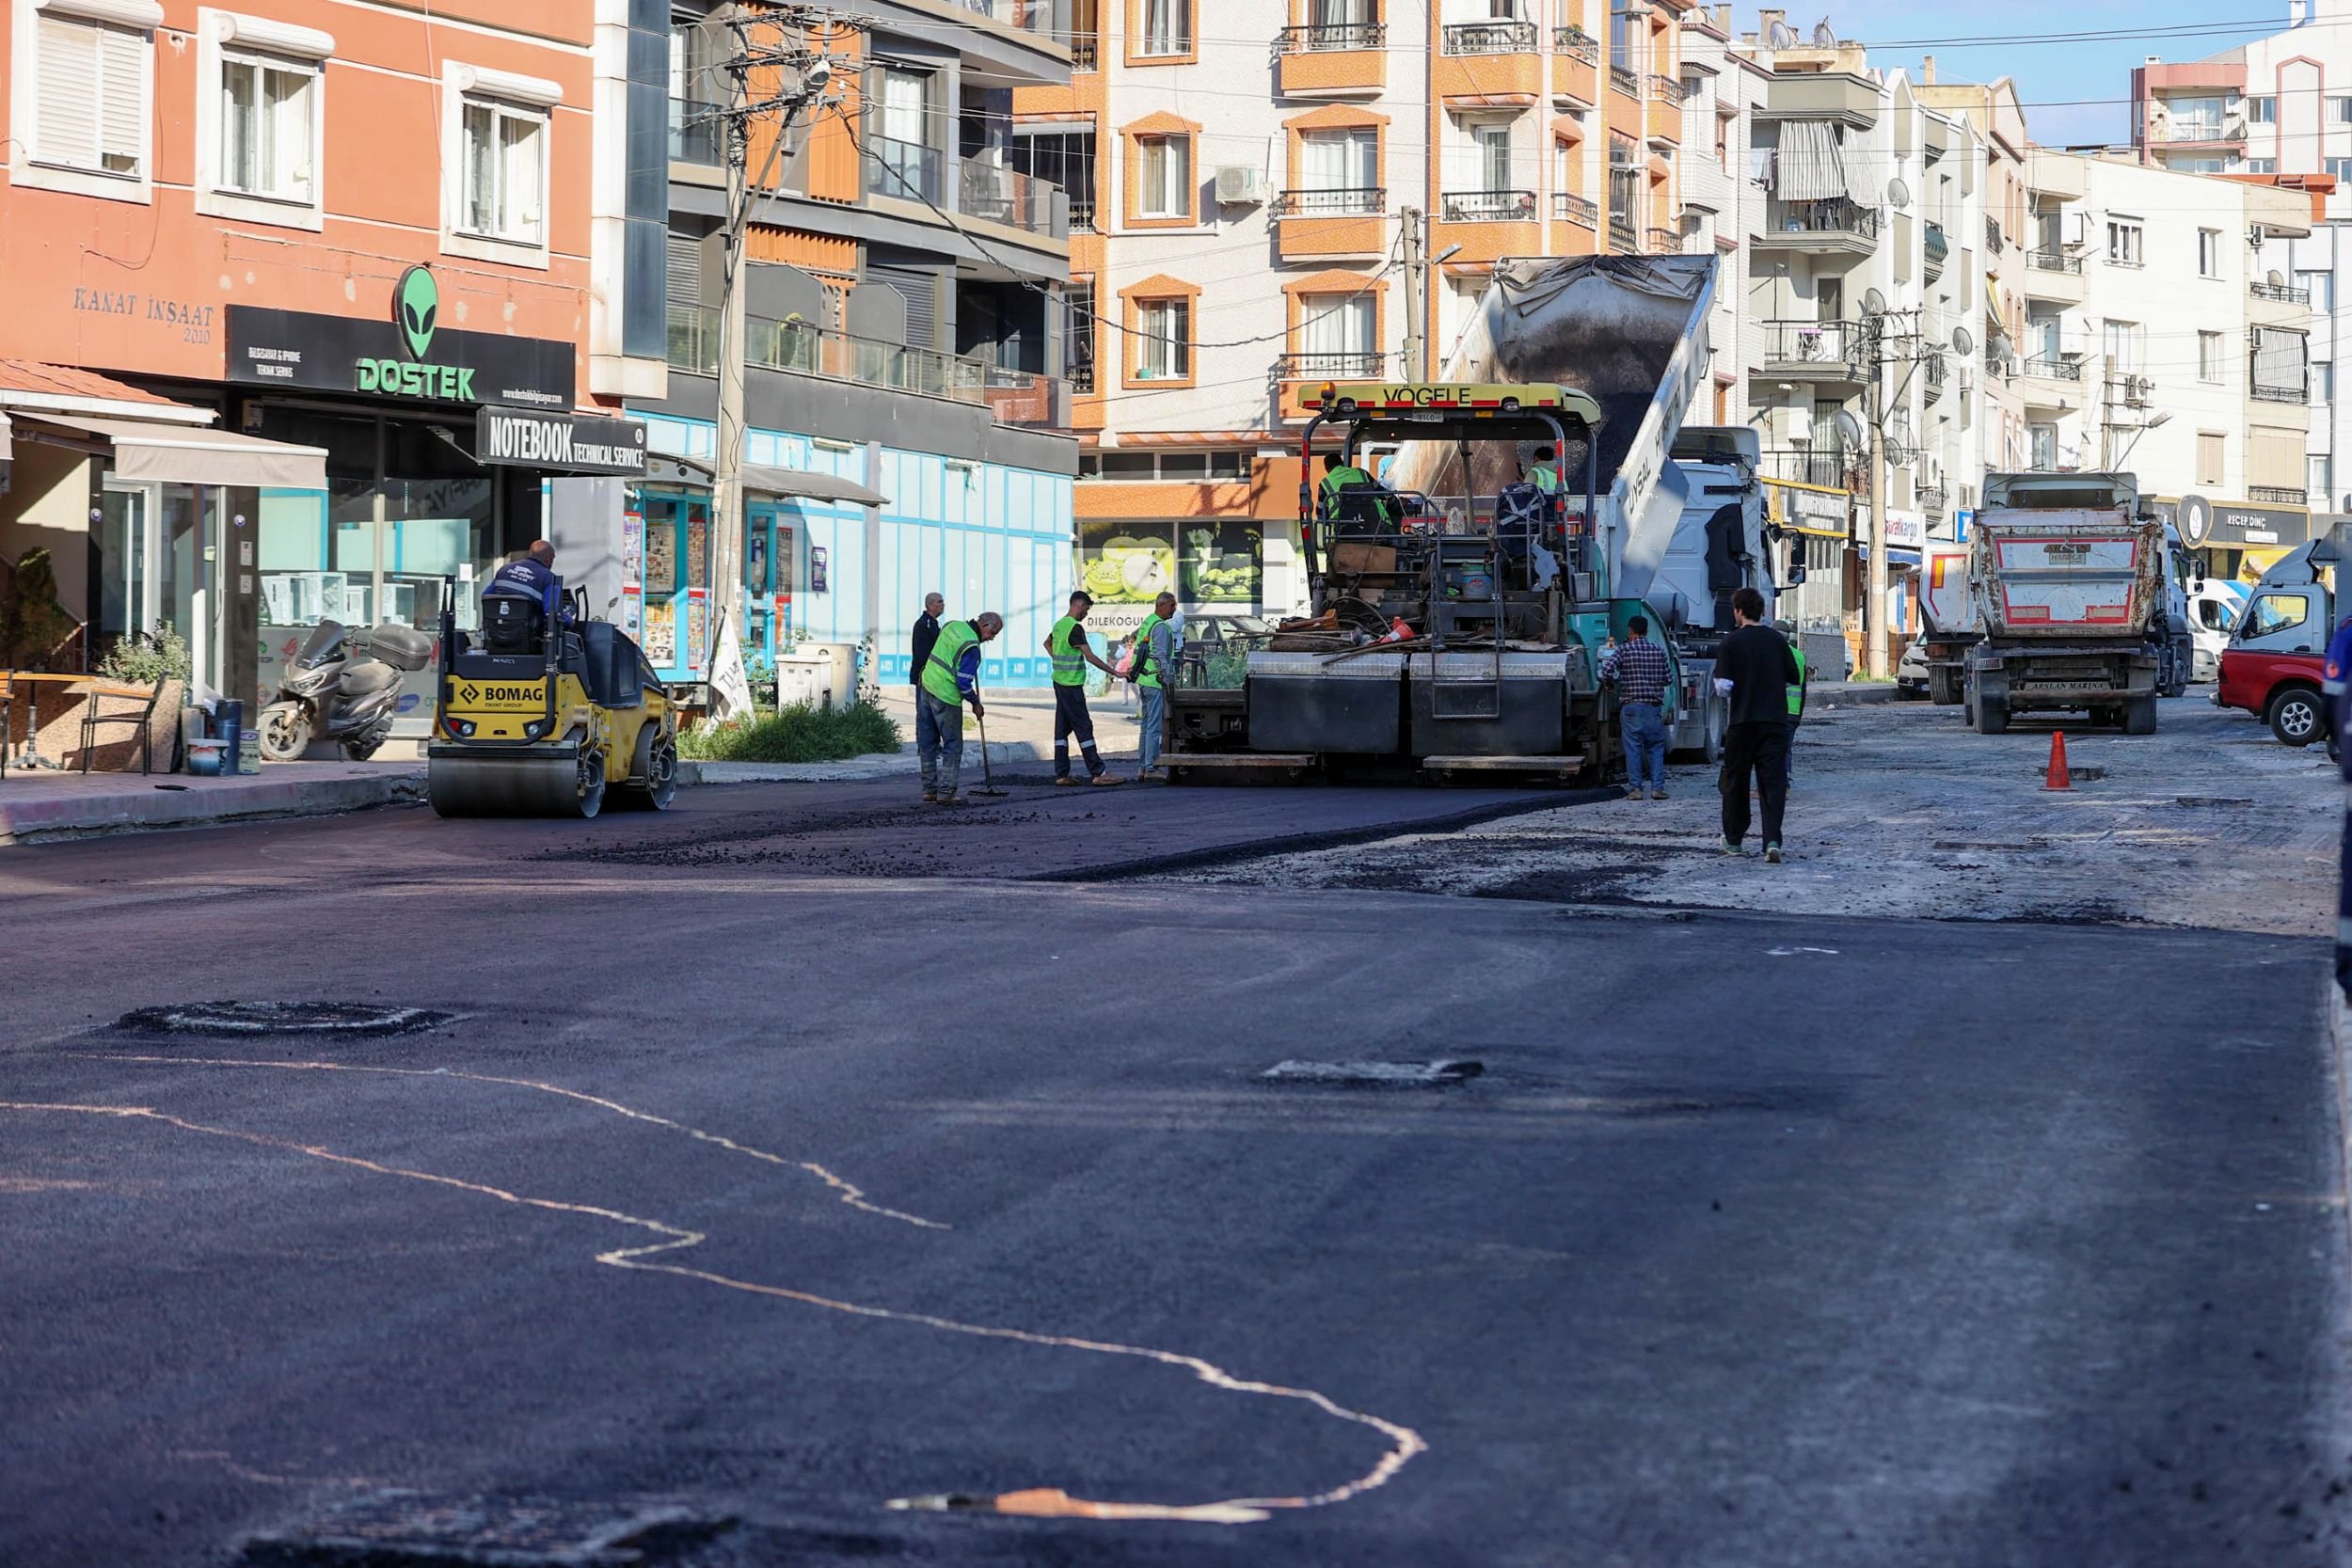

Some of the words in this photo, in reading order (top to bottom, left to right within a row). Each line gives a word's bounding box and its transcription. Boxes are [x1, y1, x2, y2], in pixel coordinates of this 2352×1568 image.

[73, 287, 136, 315] KANAT
[183, 327, 211, 344] 2010
[357, 357, 476, 401] DOSTEK
[1384, 385, 1470, 405] VÖGELE
[489, 416, 574, 463] NOTEBOOK
[574, 443, 612, 466] TECHNICAL
[613, 449, 644, 468] SERVICE
[1629, 456, 1651, 515] UYSAL
[2227, 514, 2249, 526] RECEP
[2249, 514, 2266, 531] DİNÇ
[485, 688, 543, 701] BOMAG
[2032, 682, 2066, 690] ARSLAN
